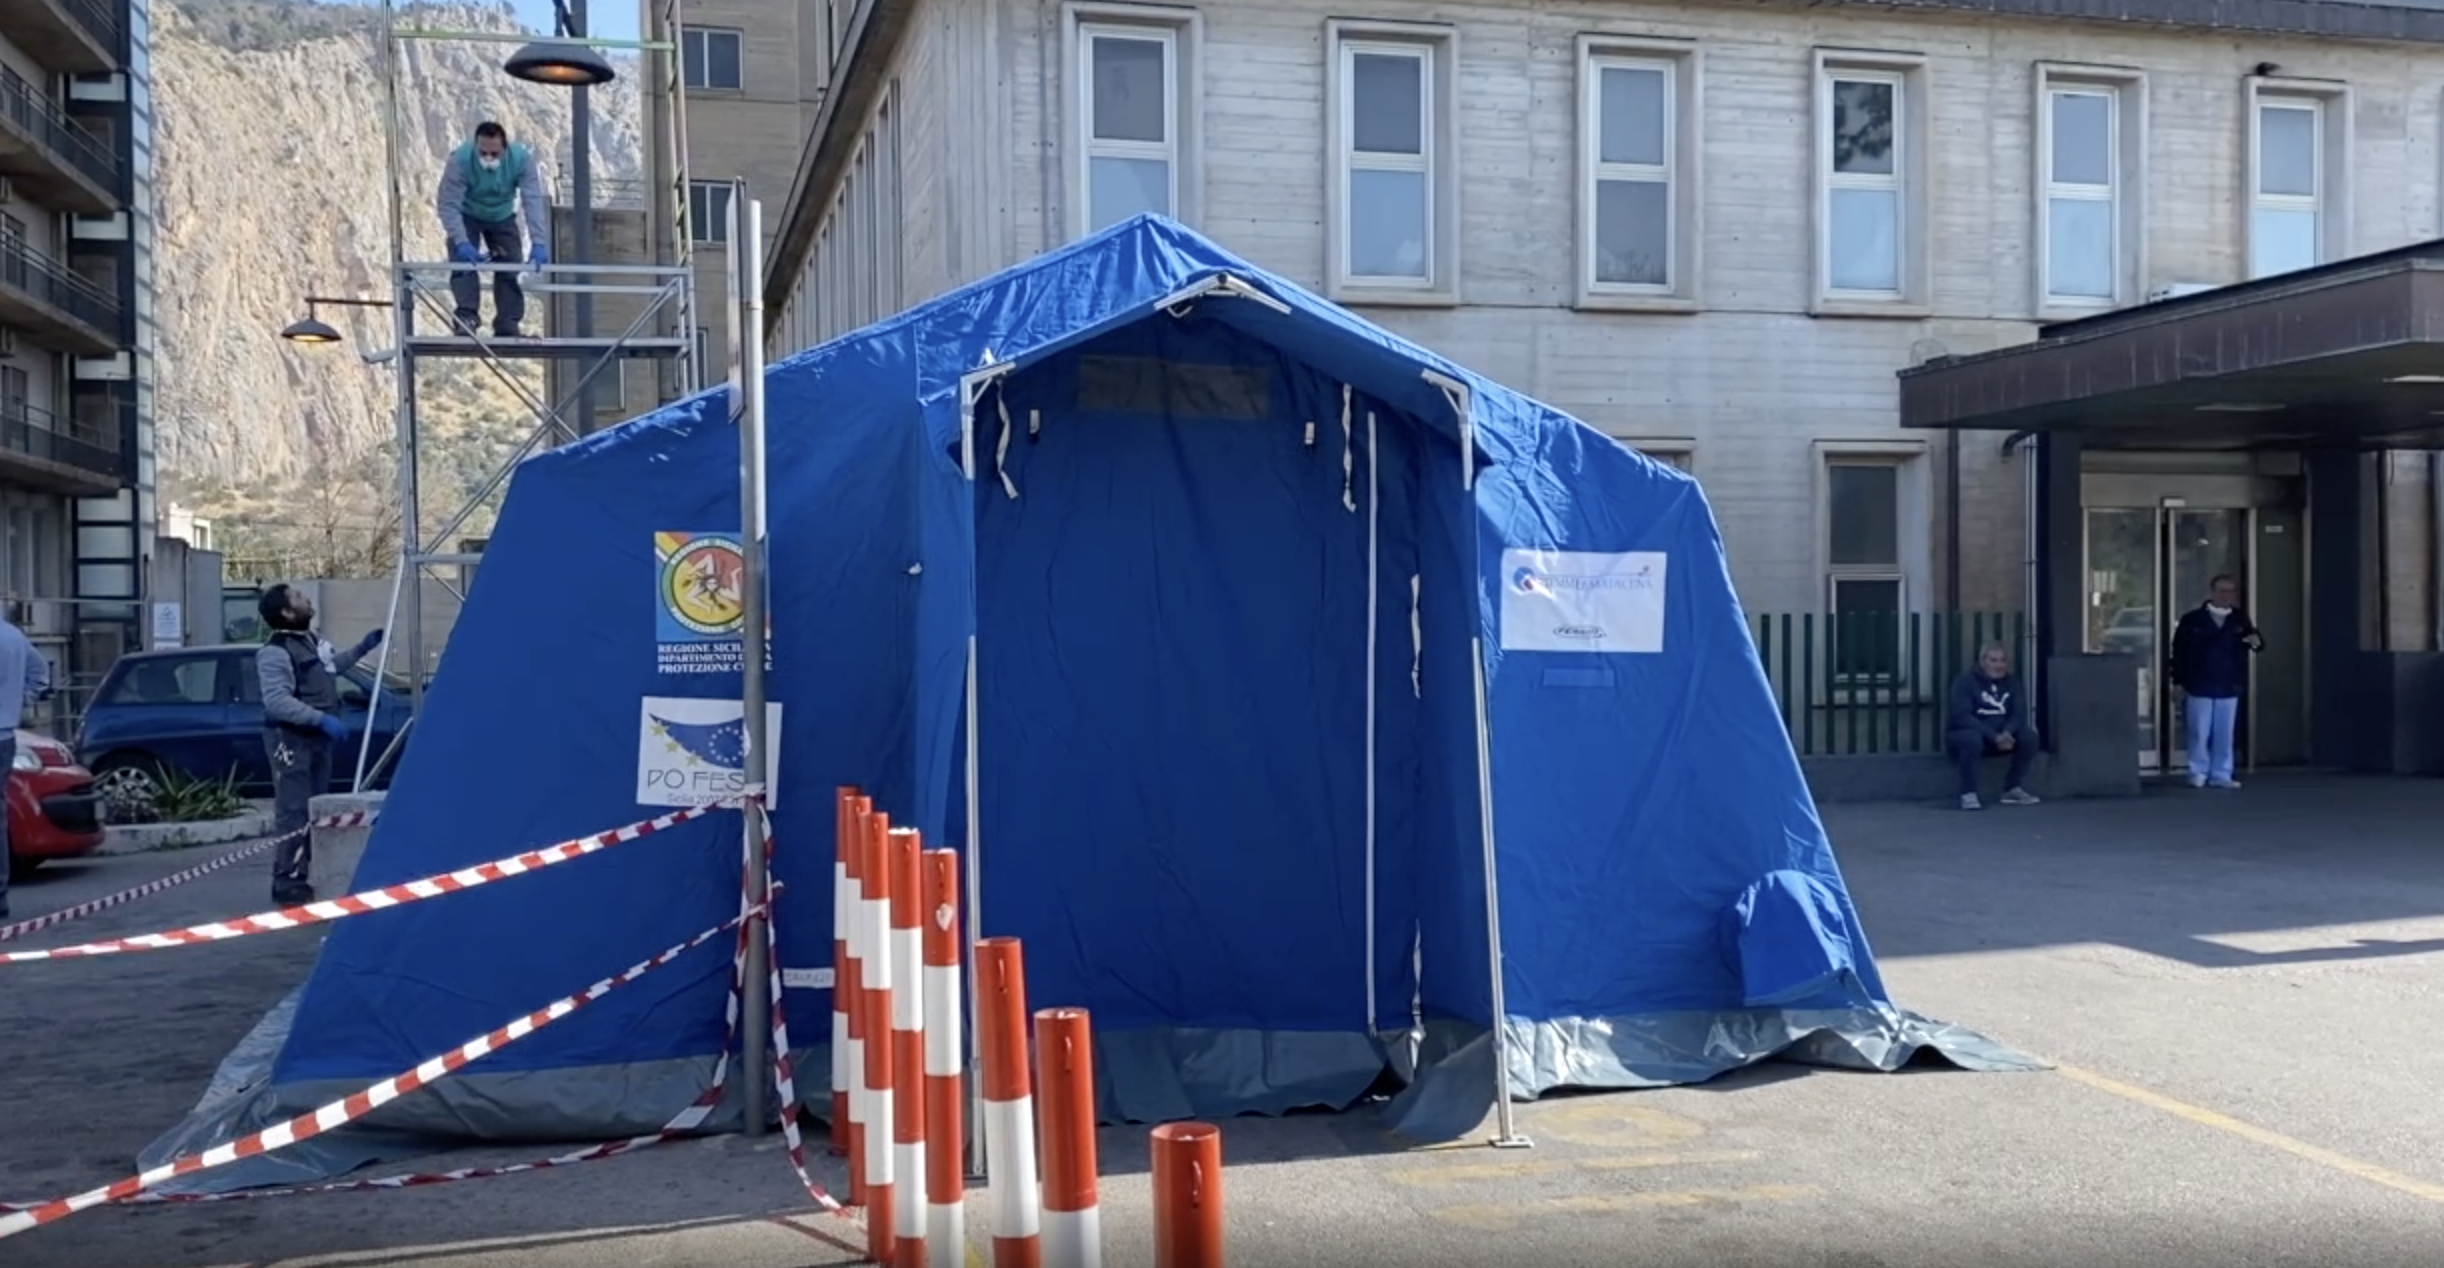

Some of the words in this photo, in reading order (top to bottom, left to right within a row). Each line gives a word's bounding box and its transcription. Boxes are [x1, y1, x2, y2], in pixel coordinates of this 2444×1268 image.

[657, 643, 711, 653] REGIONE
[657, 653, 736, 663] DIPARTIMENTO
[657, 662, 731, 673] PROTEZIONE
[647, 768, 686, 790] PO
